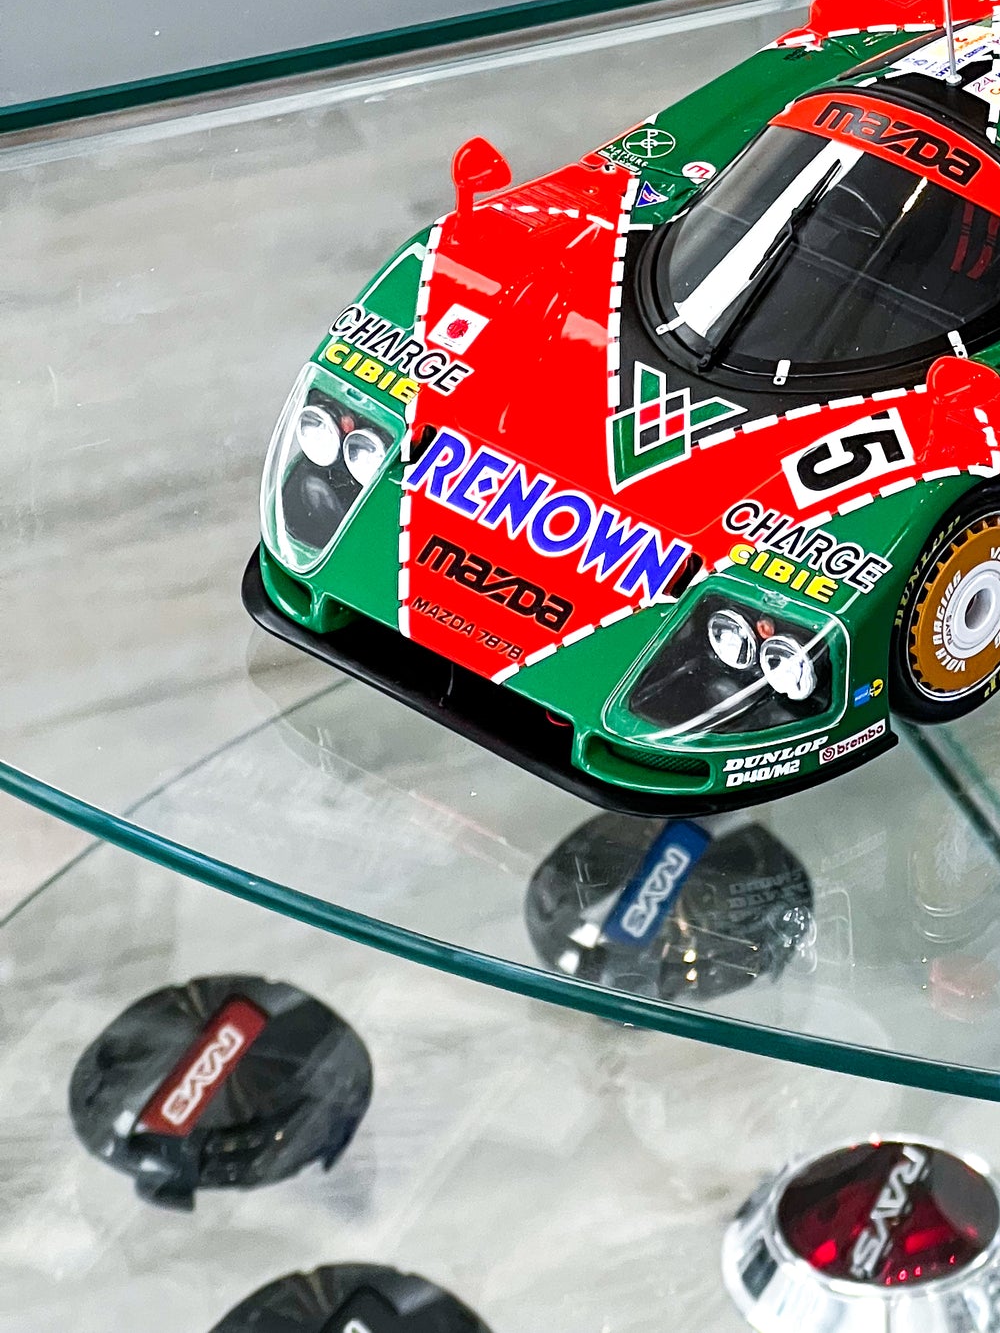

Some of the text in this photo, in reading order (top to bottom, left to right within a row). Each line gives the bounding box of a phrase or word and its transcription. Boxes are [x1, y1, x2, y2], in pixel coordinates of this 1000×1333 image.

[814, 100, 983, 187] mazda
[328, 303, 476, 397] CHARGE
[796, 410, 906, 492] 5
[402, 427, 691, 600] RENOWN
[723, 499, 893, 594] CHARGE
[415, 534, 576, 633] mazda
[411, 596, 525, 661] MAZDA 787B
[722, 735, 829, 773] DUNLOP
[725, 759, 801, 788] D40/M2
[836, 723, 884, 756] brembo
